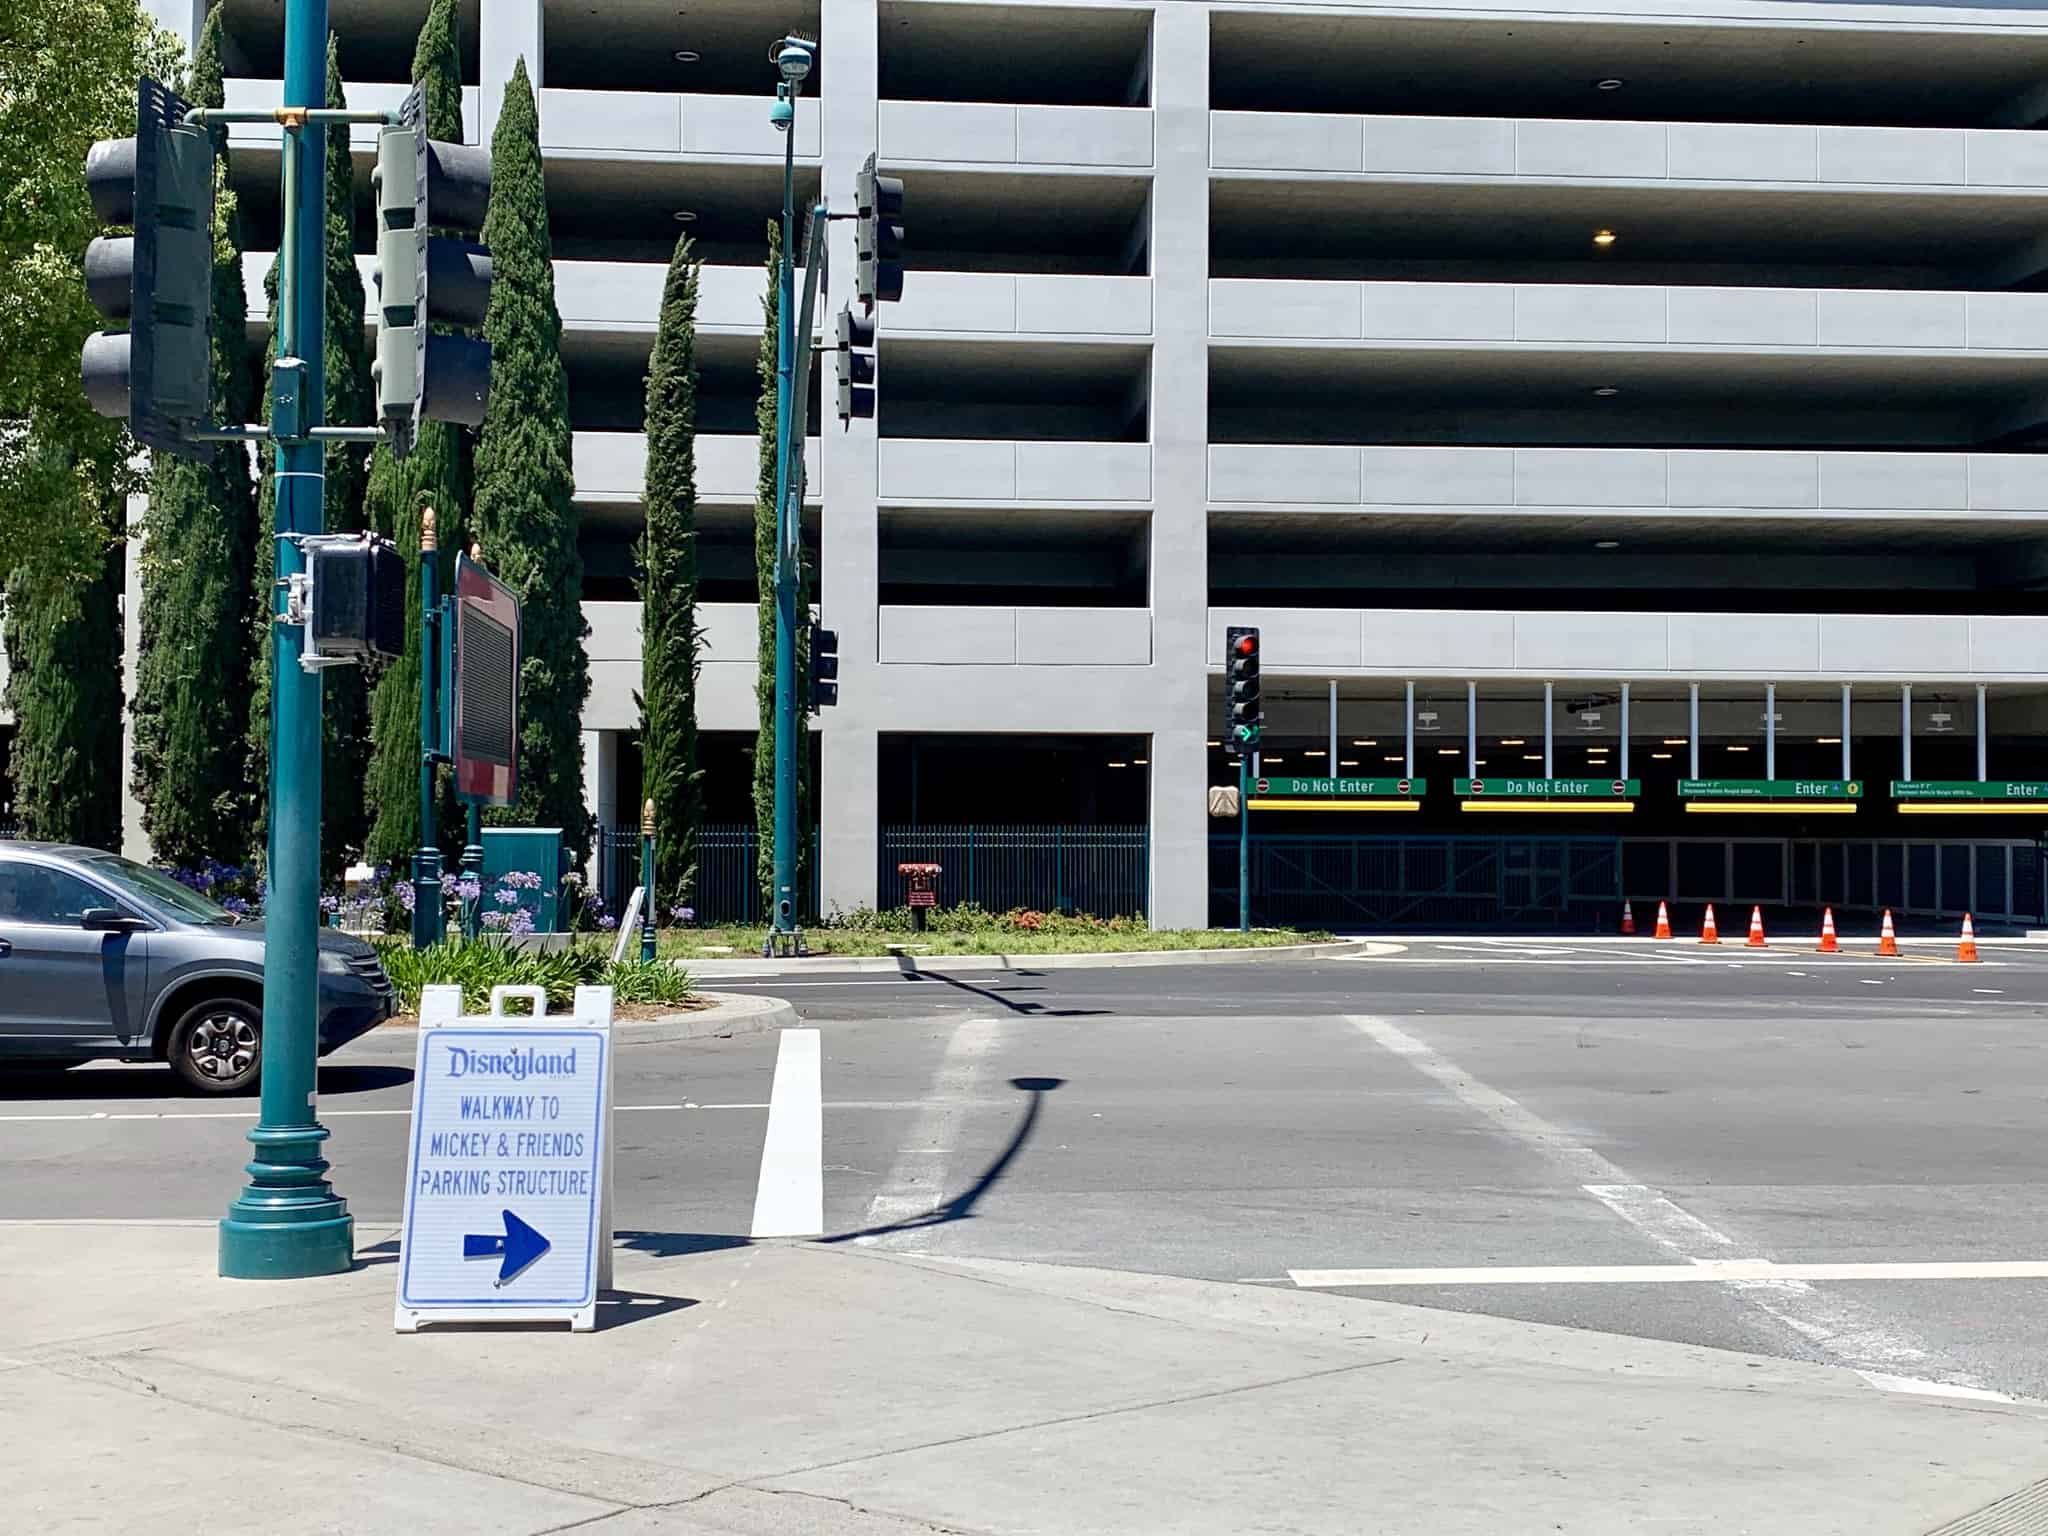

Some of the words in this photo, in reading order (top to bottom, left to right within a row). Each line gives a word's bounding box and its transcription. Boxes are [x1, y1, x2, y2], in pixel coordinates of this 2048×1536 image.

[1292, 780, 1308, 793] Do
[1312, 779, 1335, 793] Not
[1340, 780, 1375, 793] Enter
[1506, 780, 1522, 794] Do
[1527, 780, 1550, 794] Not
[1554, 780, 1589, 794] Enter
[1795, 781, 1828, 794] Enter
[2006, 783, 2039, 796] Enter
[446, 1046, 577, 1080] Disneyland
[460, 1095, 535, 1120] WALKWAY
[541, 1096, 560, 1120] TO
[430, 1133, 491, 1157] MICKEY
[497, 1133, 509, 1157] &
[516, 1133, 584, 1157] FRIENDS
[420, 1170, 491, 1195] PARKING
[497, 1170, 589, 1195] STRUCTURE
